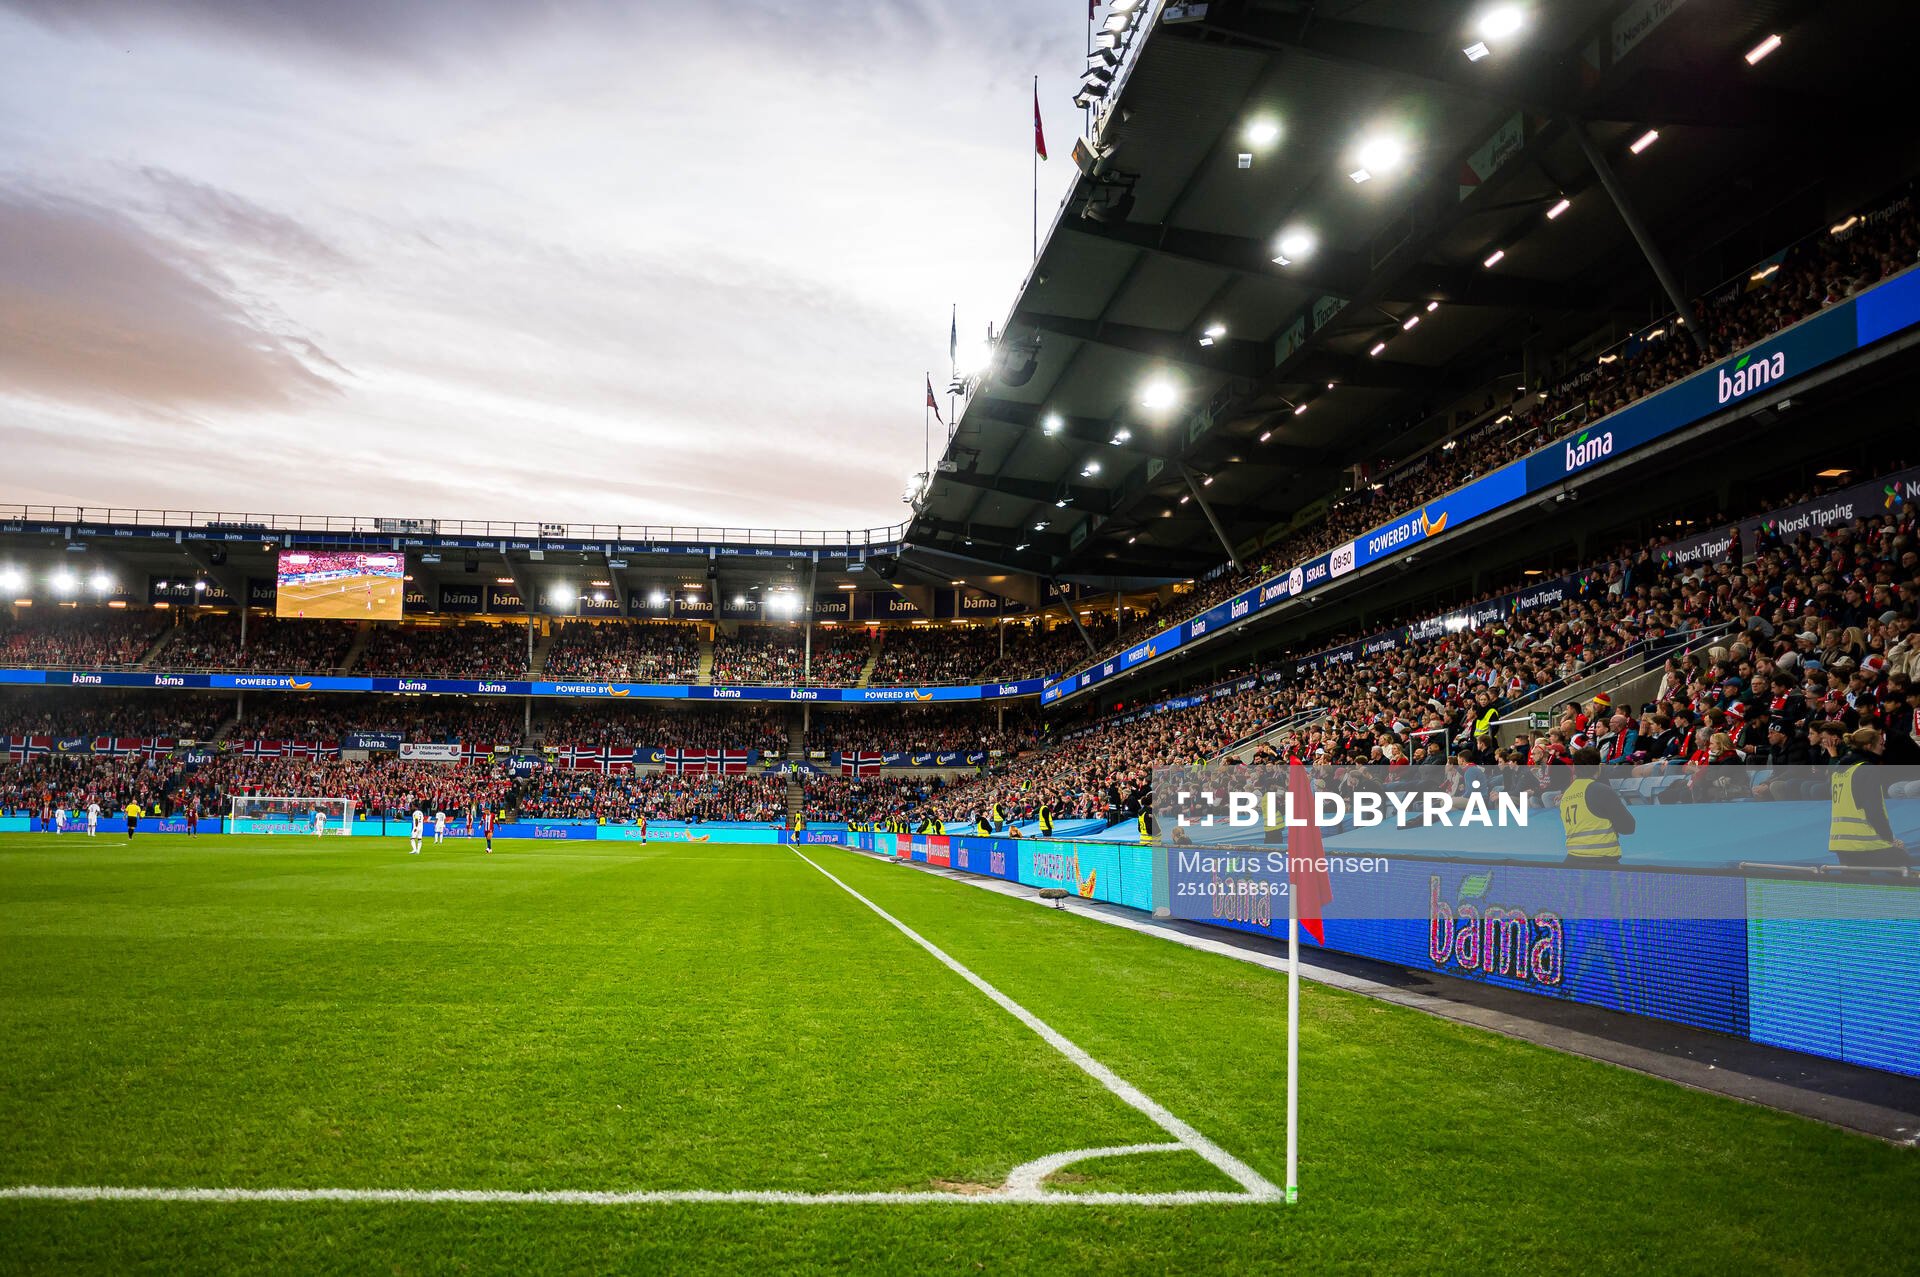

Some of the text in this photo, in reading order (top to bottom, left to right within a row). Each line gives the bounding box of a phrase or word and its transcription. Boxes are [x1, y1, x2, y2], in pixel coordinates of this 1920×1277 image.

[1718, 352, 1784, 404] bama
[1566, 432, 1613, 471] bama
[1779, 504, 1853, 535] Norsk Tipping
[1369, 518, 1424, 556] POWERED BY
[1676, 546, 1700, 565] Norsk
[1306, 551, 1352, 584] ISRAEL 09:50
[1266, 580, 1288, 600] NORWAY
[587, 598, 620, 608] bama
[964, 597, 996, 608] bama
[1521, 588, 1562, 608] Norsk Tipping
[680, 601, 713, 611] bama
[1232, 600, 1249, 619] bama
[1380, 638, 1396, 650] Tipping
[72, 673, 102, 684] bama
[155, 675, 184, 686] bama
[236, 678, 278, 686] POWERED
[398, 680, 427, 690] bama
[478, 682, 506, 693] bama
[556, 686, 608, 694] POWERED BY
[1000, 684, 1018, 694] bama
[714, 688, 740, 698] bama
[790, 690, 818, 699] bama
[865, 691, 902, 699] POWERED
[360, 738, 384, 748] bama
[1833, 783, 1844, 804] 67
[1566, 804, 1578, 826] 47
[534, 828, 566, 838] bama
[808, 832, 838, 843] bama
[1034, 852, 1064, 881] POWERED
[1212, 866, 1271, 928] bama
[1429, 874, 1564, 986] bama
